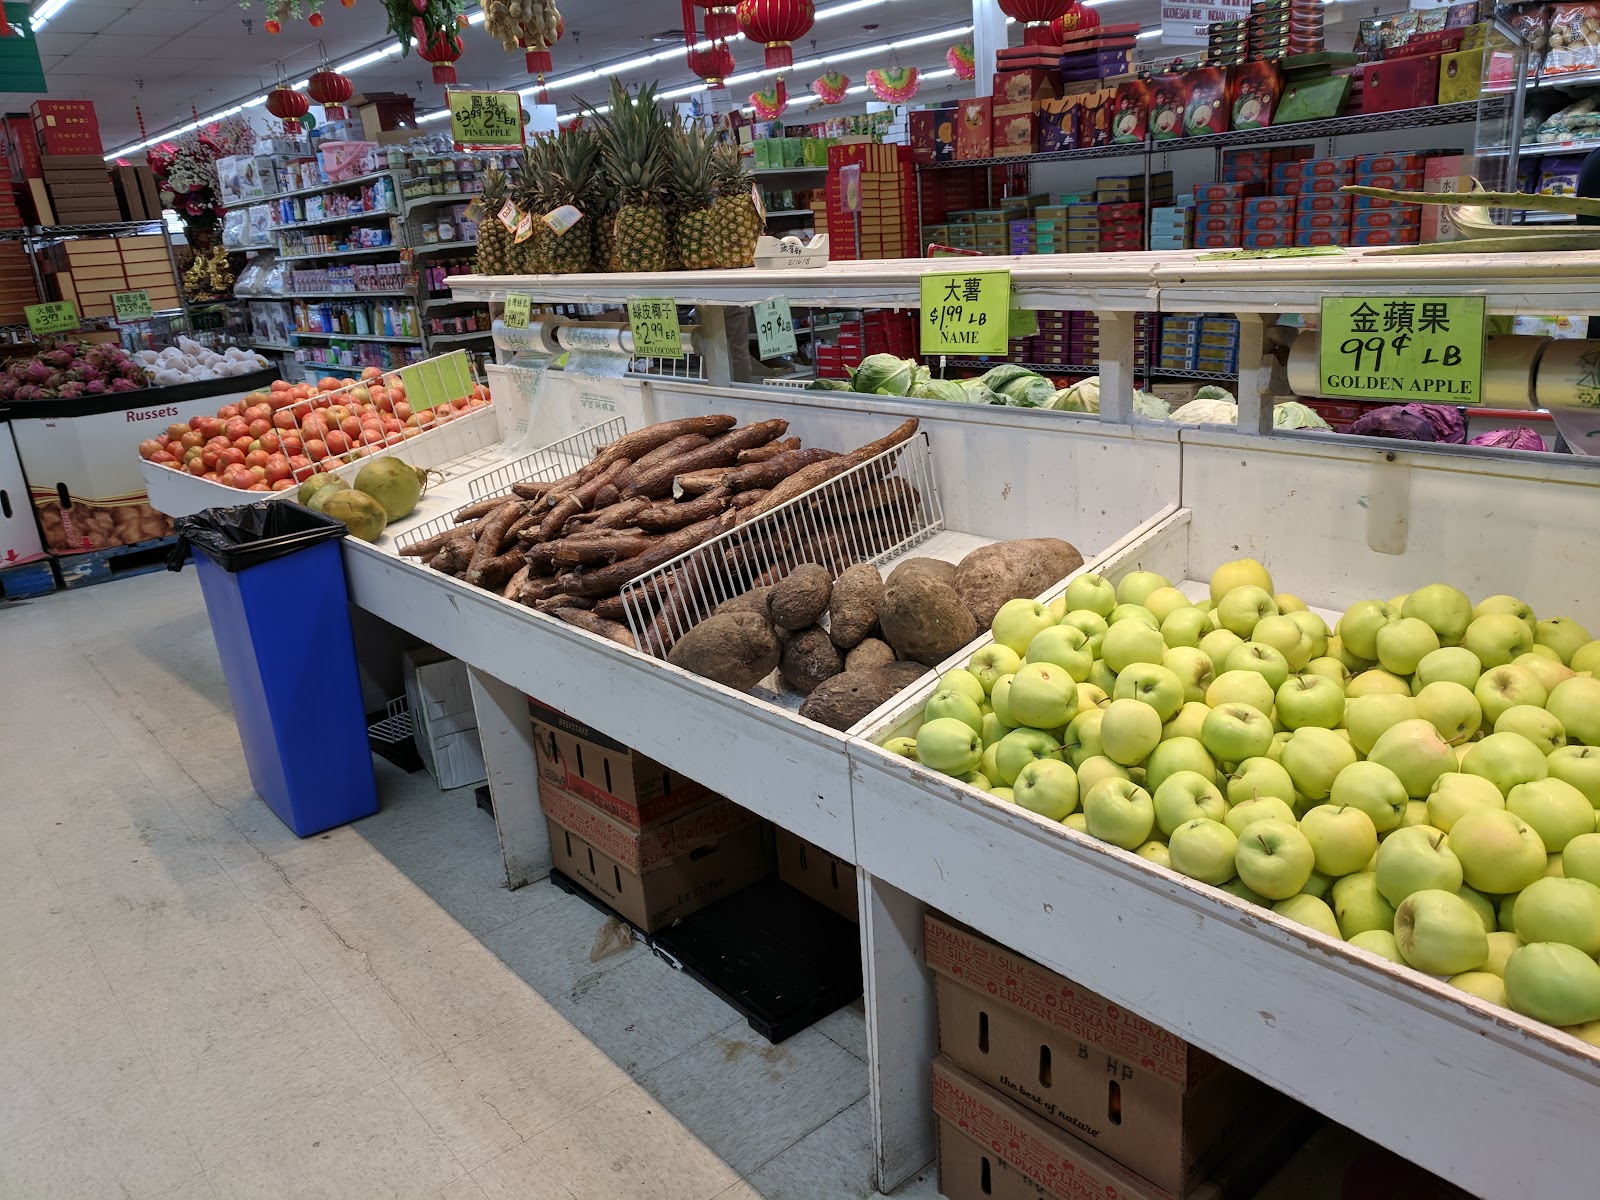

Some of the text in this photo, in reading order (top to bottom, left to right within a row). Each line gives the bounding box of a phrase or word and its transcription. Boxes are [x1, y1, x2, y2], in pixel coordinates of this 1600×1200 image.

[1208, 10, 1225, 21] INDIAN
[464, 129, 511, 137] PINEAPPLE
[944, 277, 982, 302] 大薯
[930, 305, 987, 331] $1.99 LB
[1350, 301, 1450, 334] 金蘋果
[636, 322, 677, 345] $2.99 EA
[941, 331, 979, 344] NAME
[637, 346, 680, 355] GREEN COCONUT
[1421, 345, 1462, 366] LB
[1327, 375, 1472, 394] GOLDEN APPLE
[126, 406, 178, 422] Russets
[559, 719, 589, 737] BEEFSTAKE
[924, 921, 970, 950] LIPMAN
[999, 957, 1026, 978] SILK
[948, 946, 972, 967] SILK
[999, 986, 1052, 1022] LIPMAN
[1073, 1021, 1102, 1046] SILK
[1060, 1001, 1117, 1037] LIPMAN
[1152, 1043, 1185, 1068] SILK
[1124, 1013, 1186, 1052] LIPMAN
[933, 1072, 977, 1109] LIPMAN
[1003, 1119, 1028, 1142] SILK
[955, 1101, 977, 1124] SILK
[1000, 1075, 1099, 1137] the best of nature
[1003, 1147, 1052, 1188] LIPMAN
